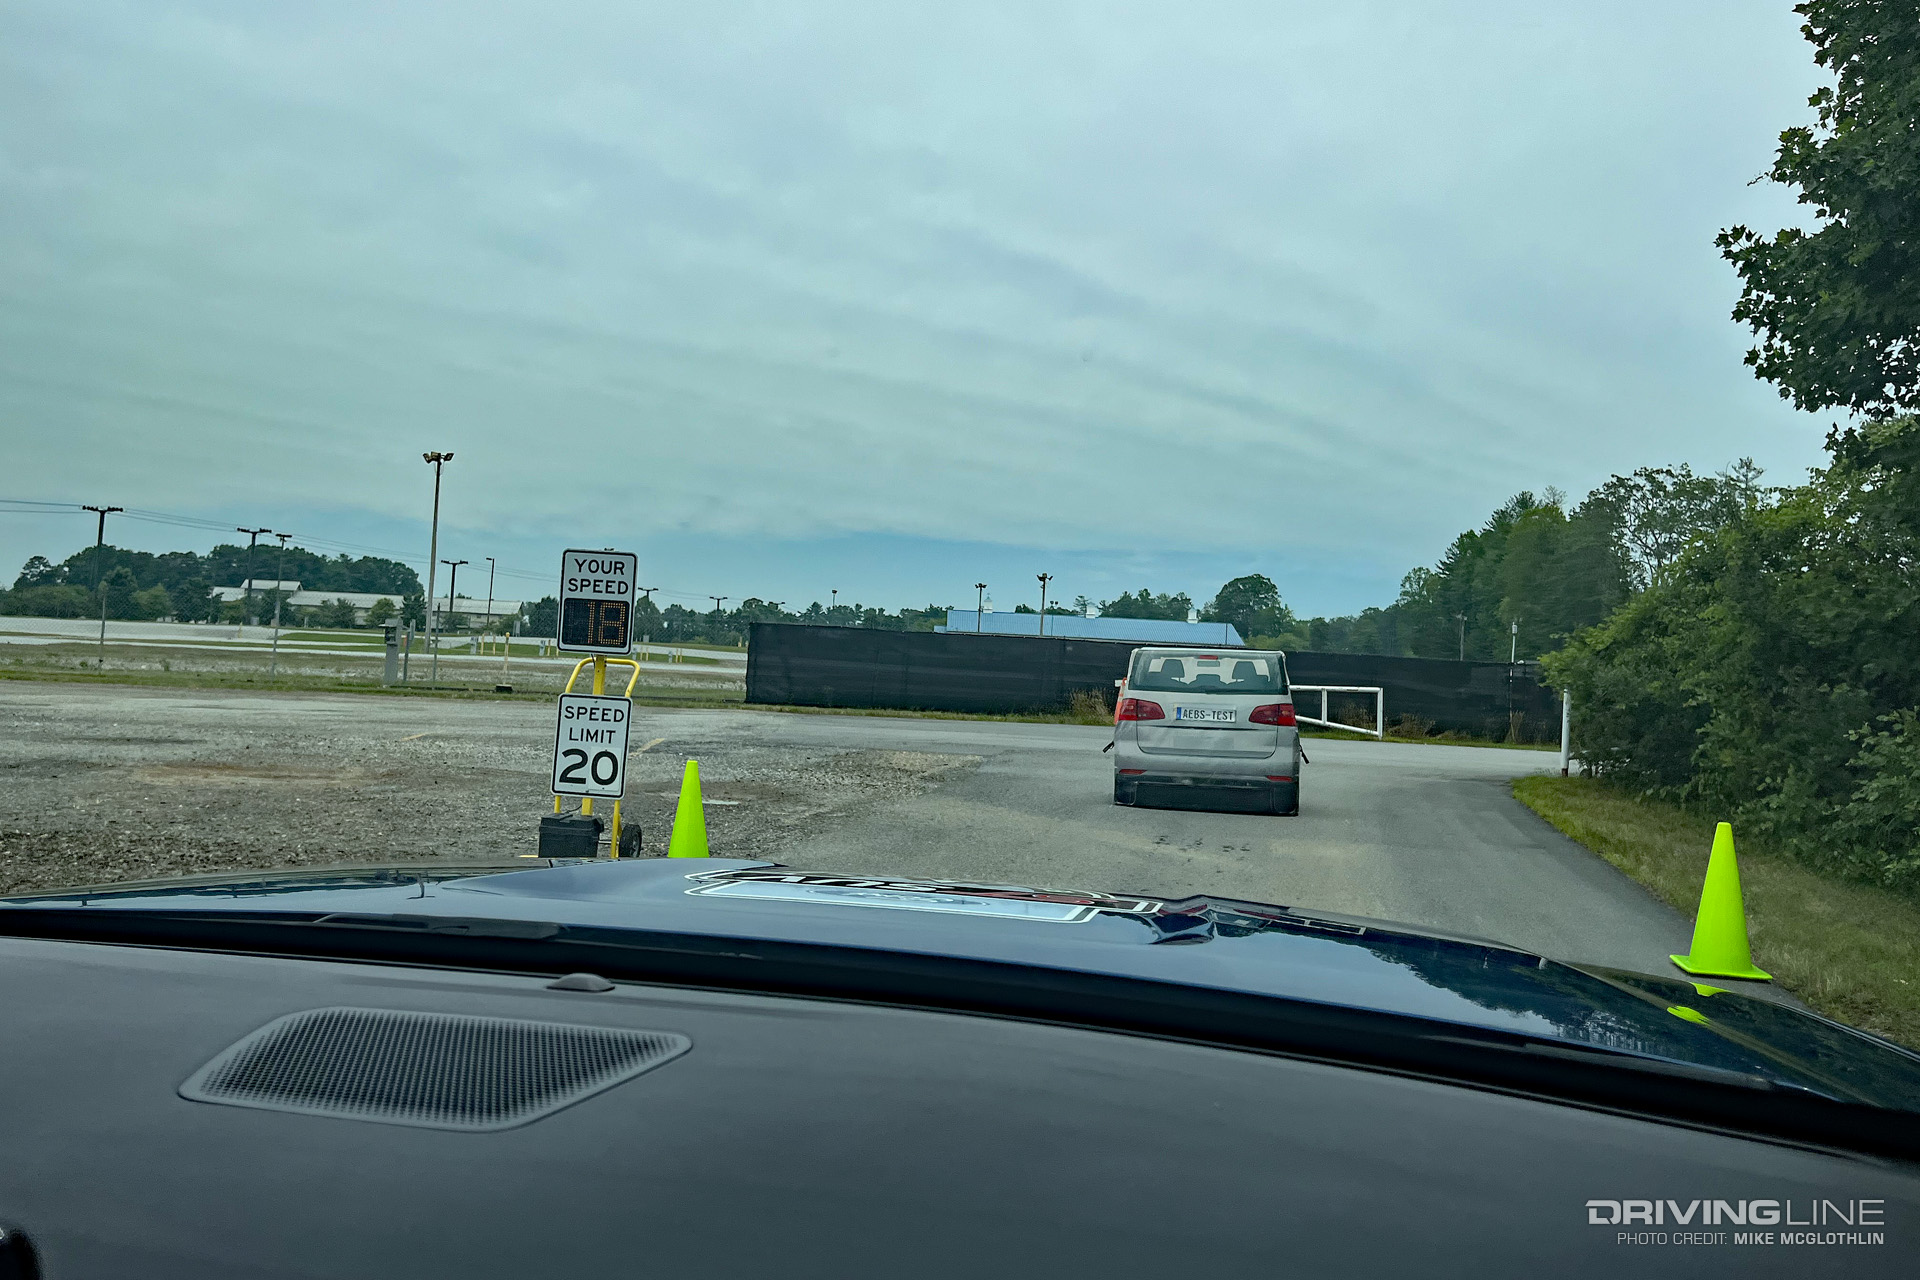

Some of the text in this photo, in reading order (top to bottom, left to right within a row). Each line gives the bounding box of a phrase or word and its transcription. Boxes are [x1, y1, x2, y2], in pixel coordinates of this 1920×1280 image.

[574, 558, 625, 575] YOUR
[568, 577, 629, 595] SPEED
[587, 601, 626, 646] 18
[564, 705, 625, 723] SPEED
[1182, 708, 1234, 721] AEBS-TEST
[569, 727, 616, 744] LIMIT
[559, 748, 619, 786] 20
